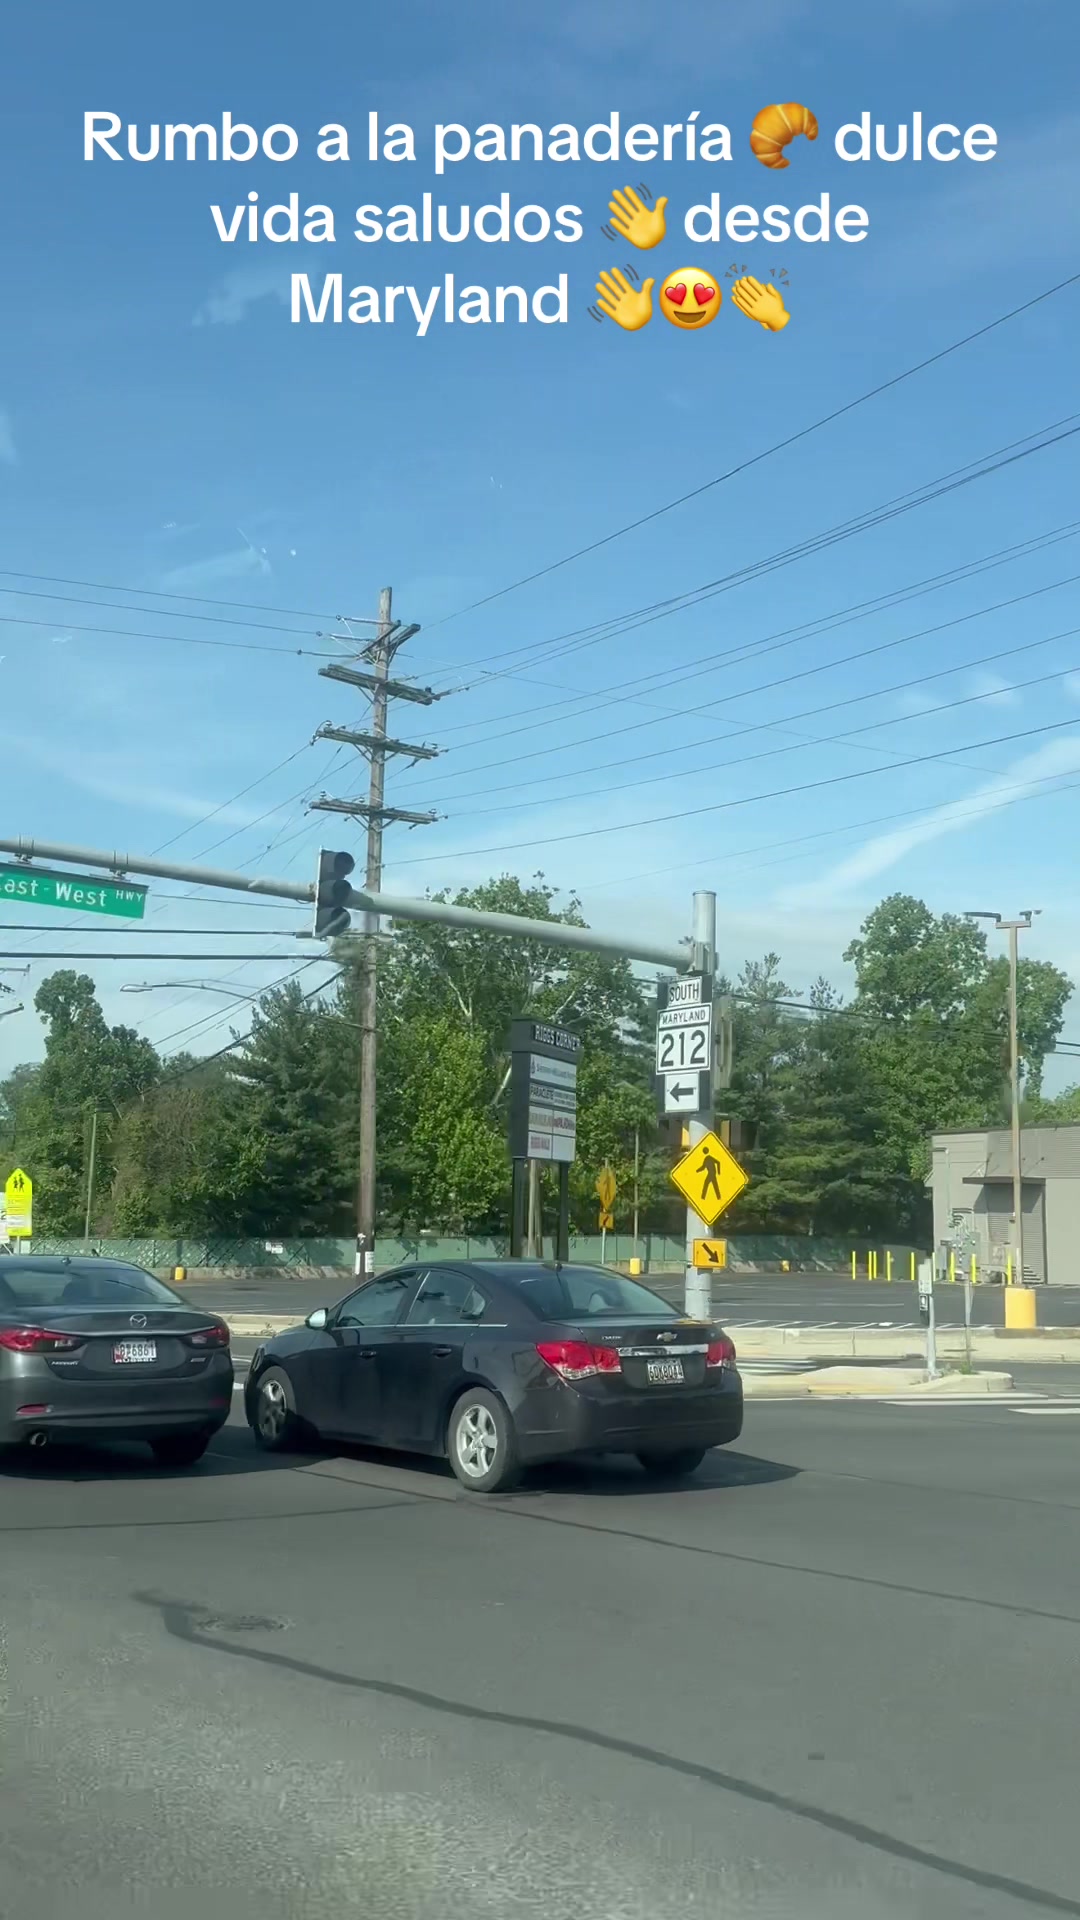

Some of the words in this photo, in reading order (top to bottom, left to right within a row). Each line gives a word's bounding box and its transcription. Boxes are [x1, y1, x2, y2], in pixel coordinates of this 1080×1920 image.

[115, 889, 144, 903] HWY
[668, 983, 700, 1002] SOUTH
[661, 1009, 706, 1025] MARYLAND
[534, 1024, 555, 1045] RIGGS
[660, 1029, 706, 1068] 212
